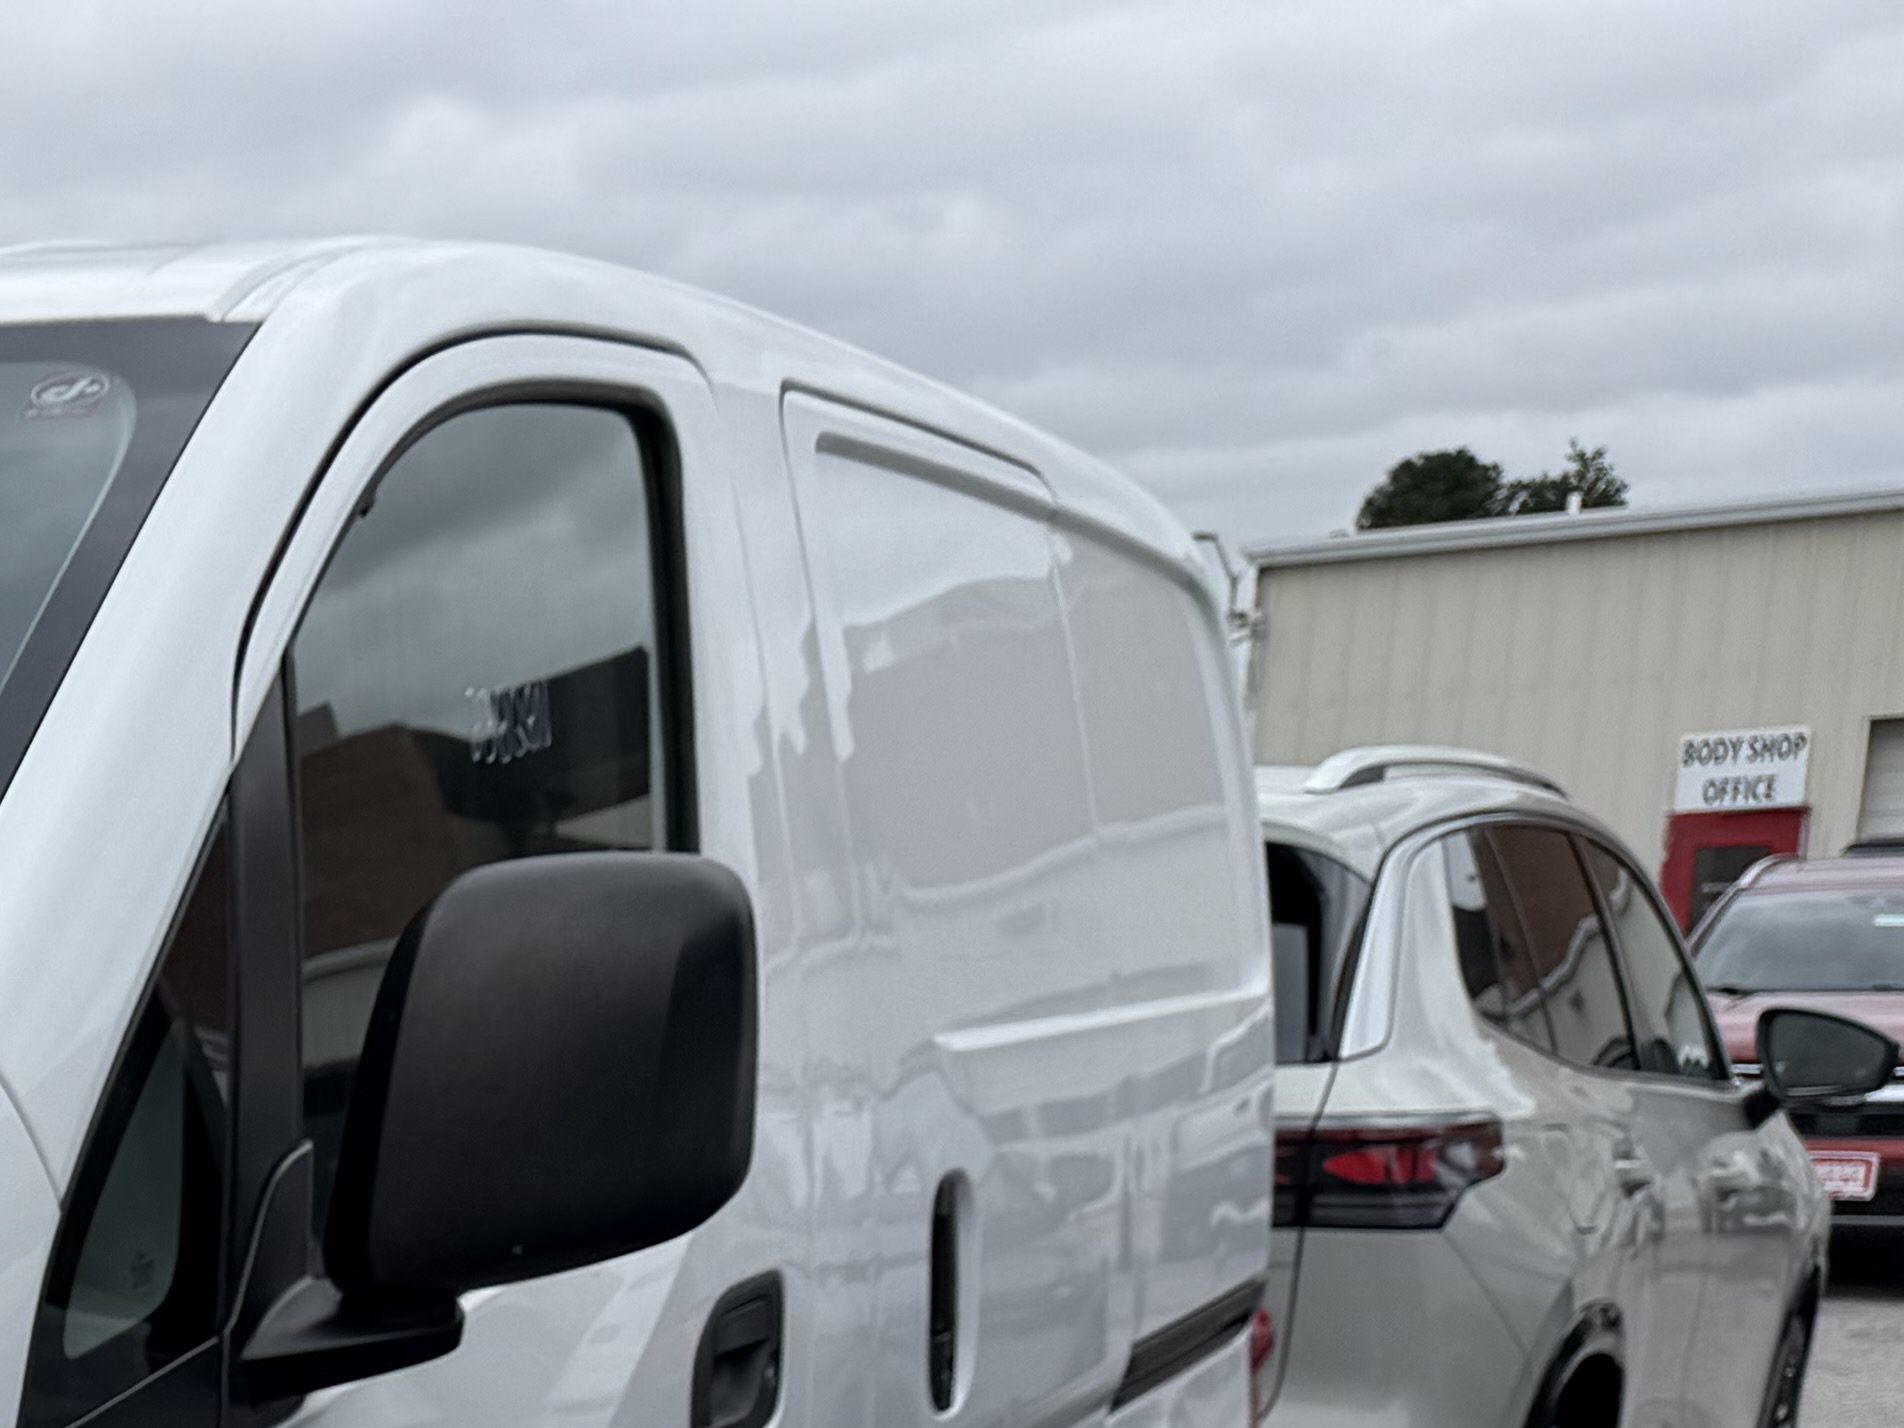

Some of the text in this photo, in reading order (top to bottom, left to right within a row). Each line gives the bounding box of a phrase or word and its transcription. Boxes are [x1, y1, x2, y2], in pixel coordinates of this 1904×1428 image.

[1684, 732, 1807, 768] BODY SHOP
[1702, 775, 1776, 805] OFFICE
